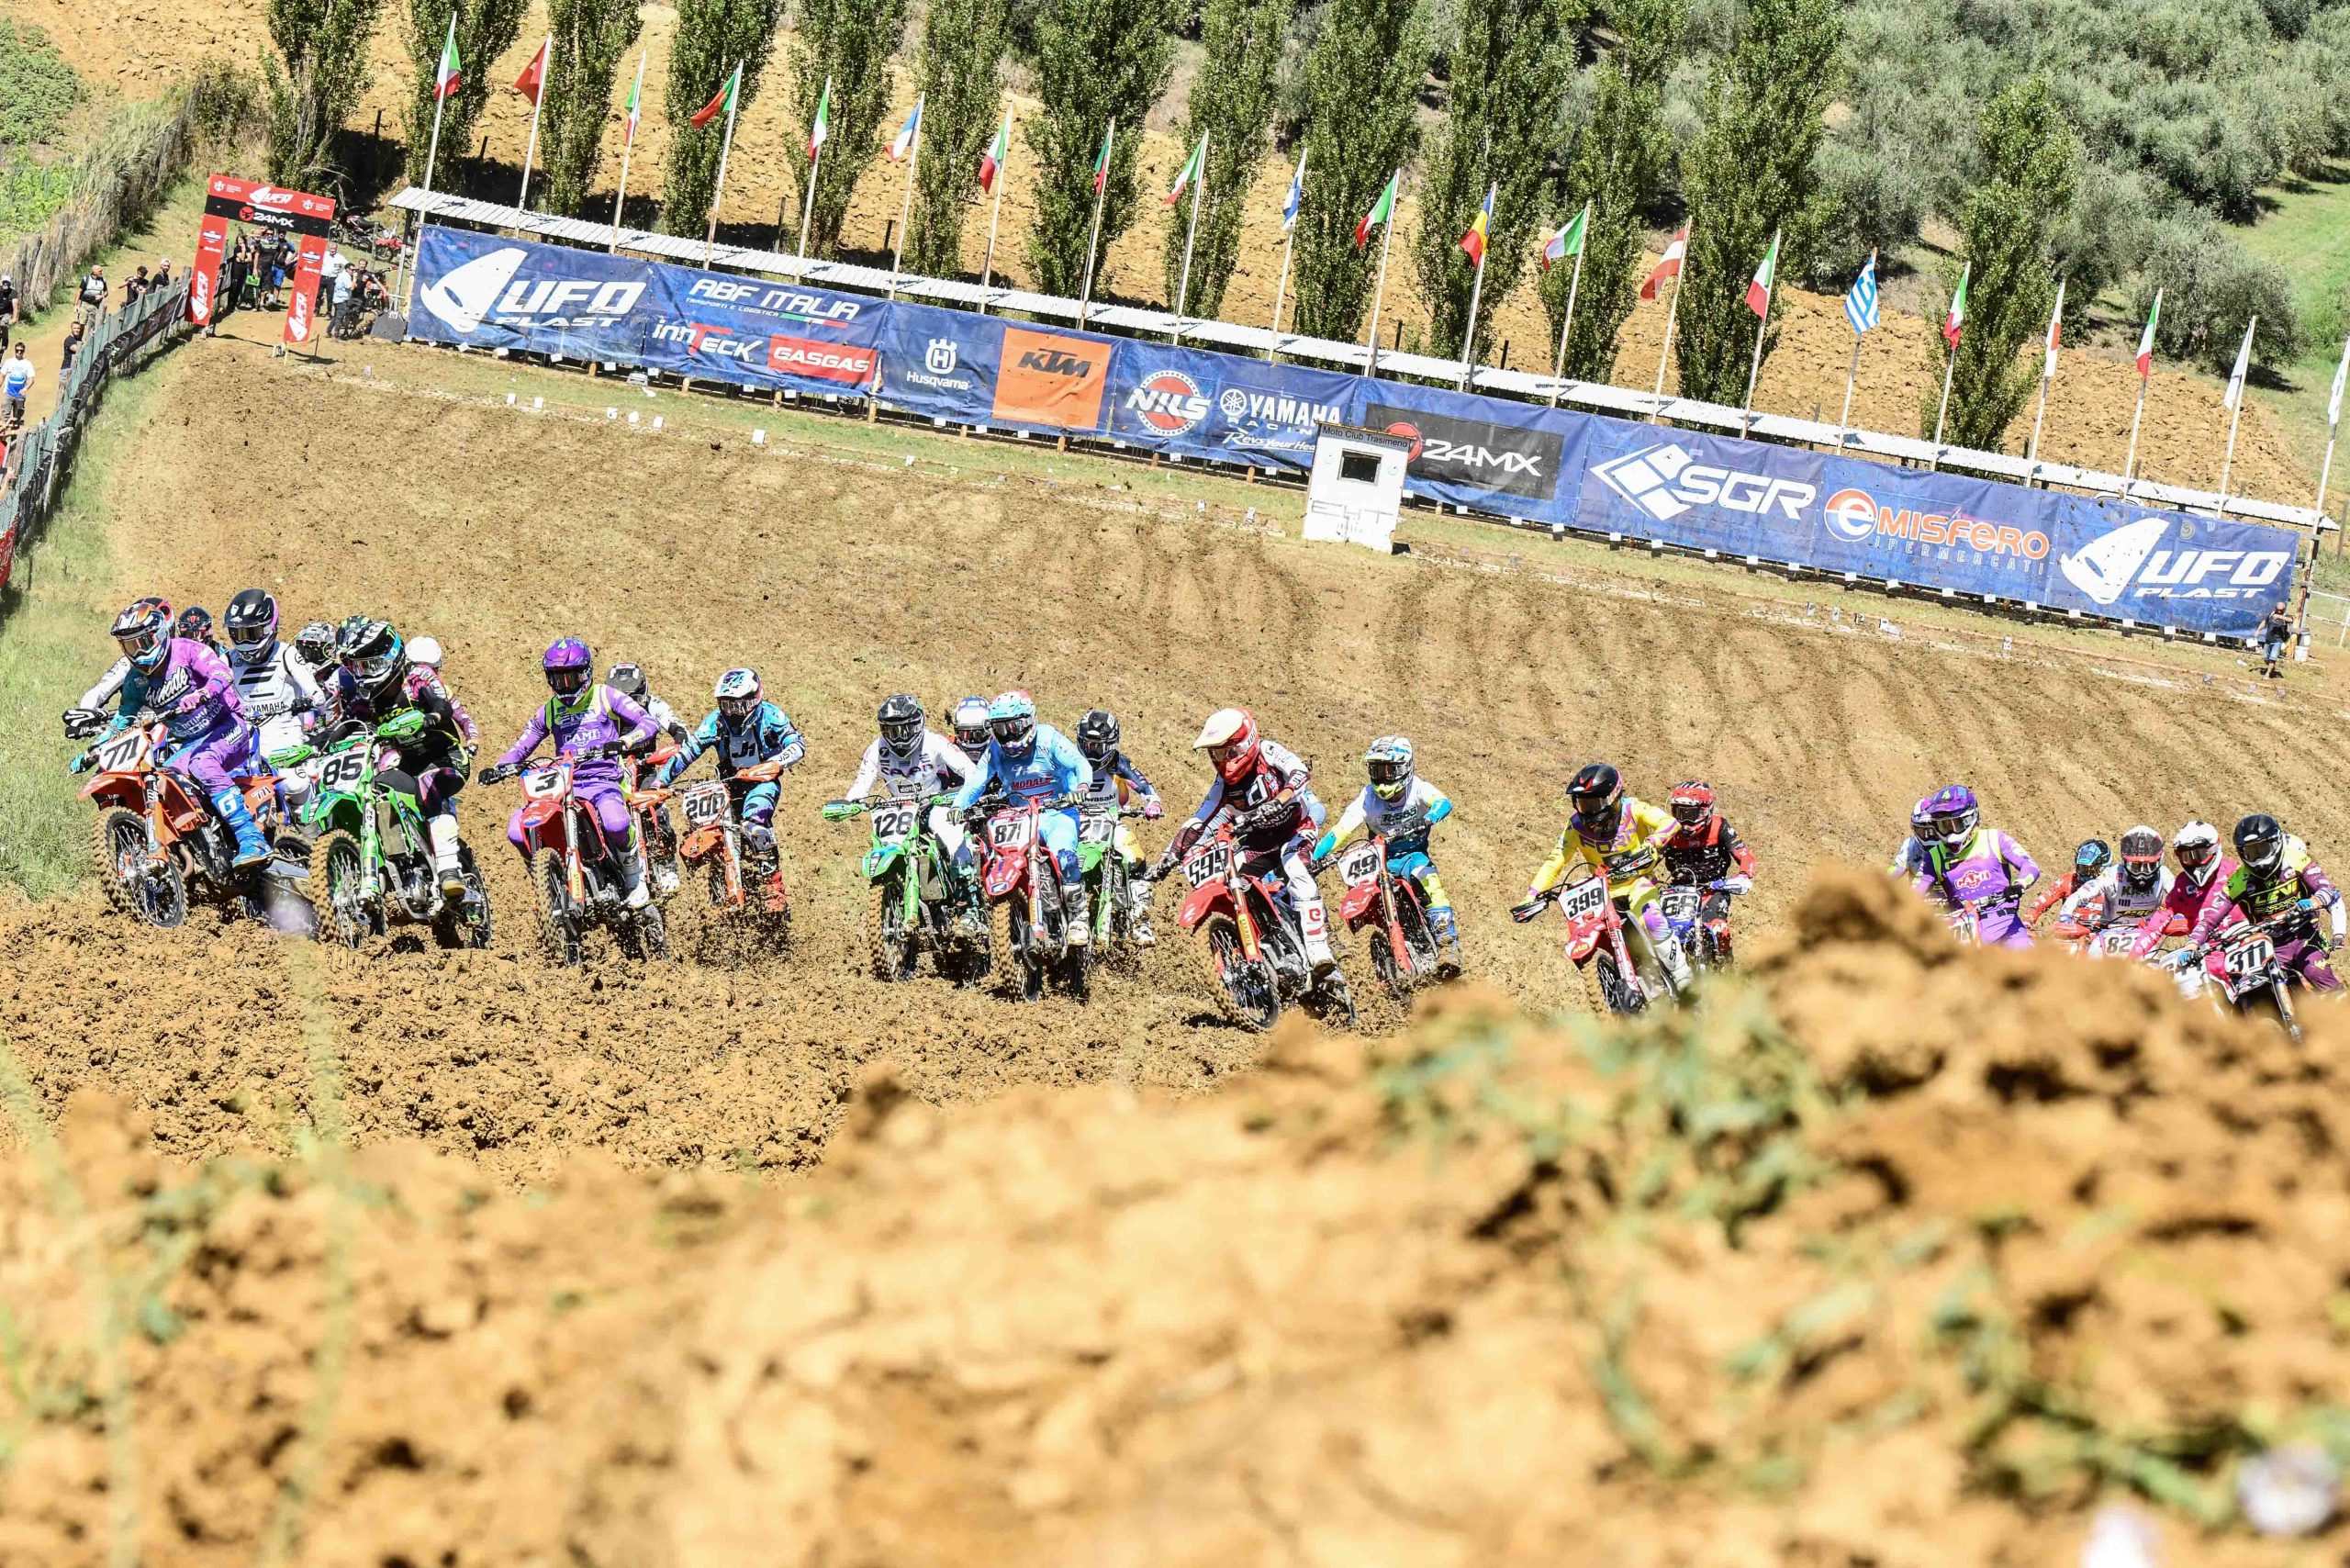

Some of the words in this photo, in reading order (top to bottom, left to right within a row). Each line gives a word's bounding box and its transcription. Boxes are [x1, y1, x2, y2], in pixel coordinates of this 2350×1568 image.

[253, 212, 295, 229] 24MX
[496, 280, 646, 315] UFO
[685, 297, 728, 309] TRASPORTI
[738, 307, 779, 318] LOGISTICA
[688, 278, 759, 302] ABF
[760, 290, 860, 320] ITALIA
[493, 316, 622, 328] PLAST
[773, 346, 870, 373] GASGAS
[1018, 347, 1092, 378] KTM
[906, 370, 969, 390] Husqvarna
[1125, 387, 1212, 420] NILS
[1249, 394, 1341, 426] YAMAHA
[1227, 417, 1313, 435] RACIN
[1322, 426, 1343, 437] Moto
[1345, 430, 1364, 441] Club
[1366, 433, 1408, 448] Trasimeno
[1422, 439, 1542, 477] 24MX
[1670, 465, 1817, 521] SGR
[1874, 535, 2044, 577] IPERMERCATI
[2137, 550, 2291, 585] UFO
[2133, 588, 2267, 599] PLAST
[251, 700, 285, 713] YAMAHA
[563, 730, 600, 745] CAMI
[104, 734, 140, 773] 771
[322, 751, 365, 786] 85
[534, 771, 560, 792] 3
[250, 785, 272, 802] 771
[686, 792, 726, 820] 200
[874, 811, 914, 839] 128
[1347, 853, 1378, 879] 49
[1954, 869, 1992, 890] CAMI
[1567, 887, 1605, 918] 399
[2228, 939, 2267, 972] 311
